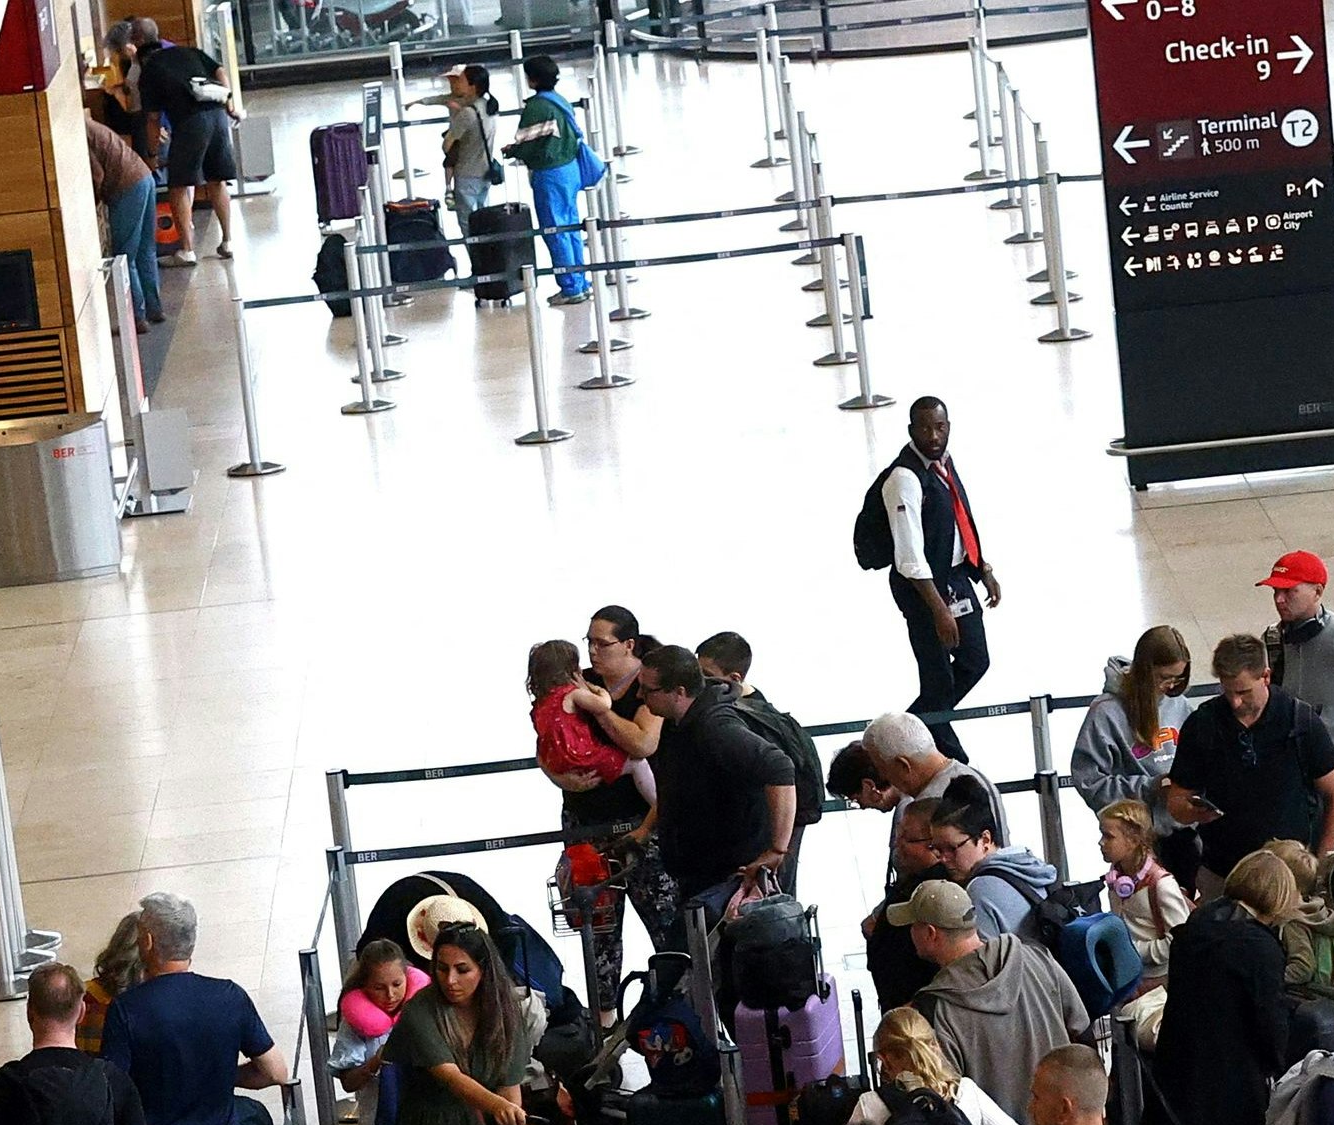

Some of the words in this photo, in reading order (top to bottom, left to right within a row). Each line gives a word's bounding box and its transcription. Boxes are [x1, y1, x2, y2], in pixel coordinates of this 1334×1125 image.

[1165, 34, 1269, 63] Check-in
[1256, 61, 1271, 80] 9
[1197, 111, 1278, 135] Terminal
[1286, 119, 1313, 138] T2
[1215, 138, 1242, 153] 500
[1246, 138, 1260, 151] m
[1159, 191, 1188, 203] Airline
[1189, 189, 1219, 200] Service
[1160, 201, 1194, 212] Counter
[1283, 209, 1313, 221] Airport
[1283, 221, 1301, 231] City
[53, 447, 76, 459] BER
[988, 705, 1008, 716] BER
[424, 768, 445, 779] BER
[485, 838, 506, 850] BER
[357, 851, 377, 862] BER
